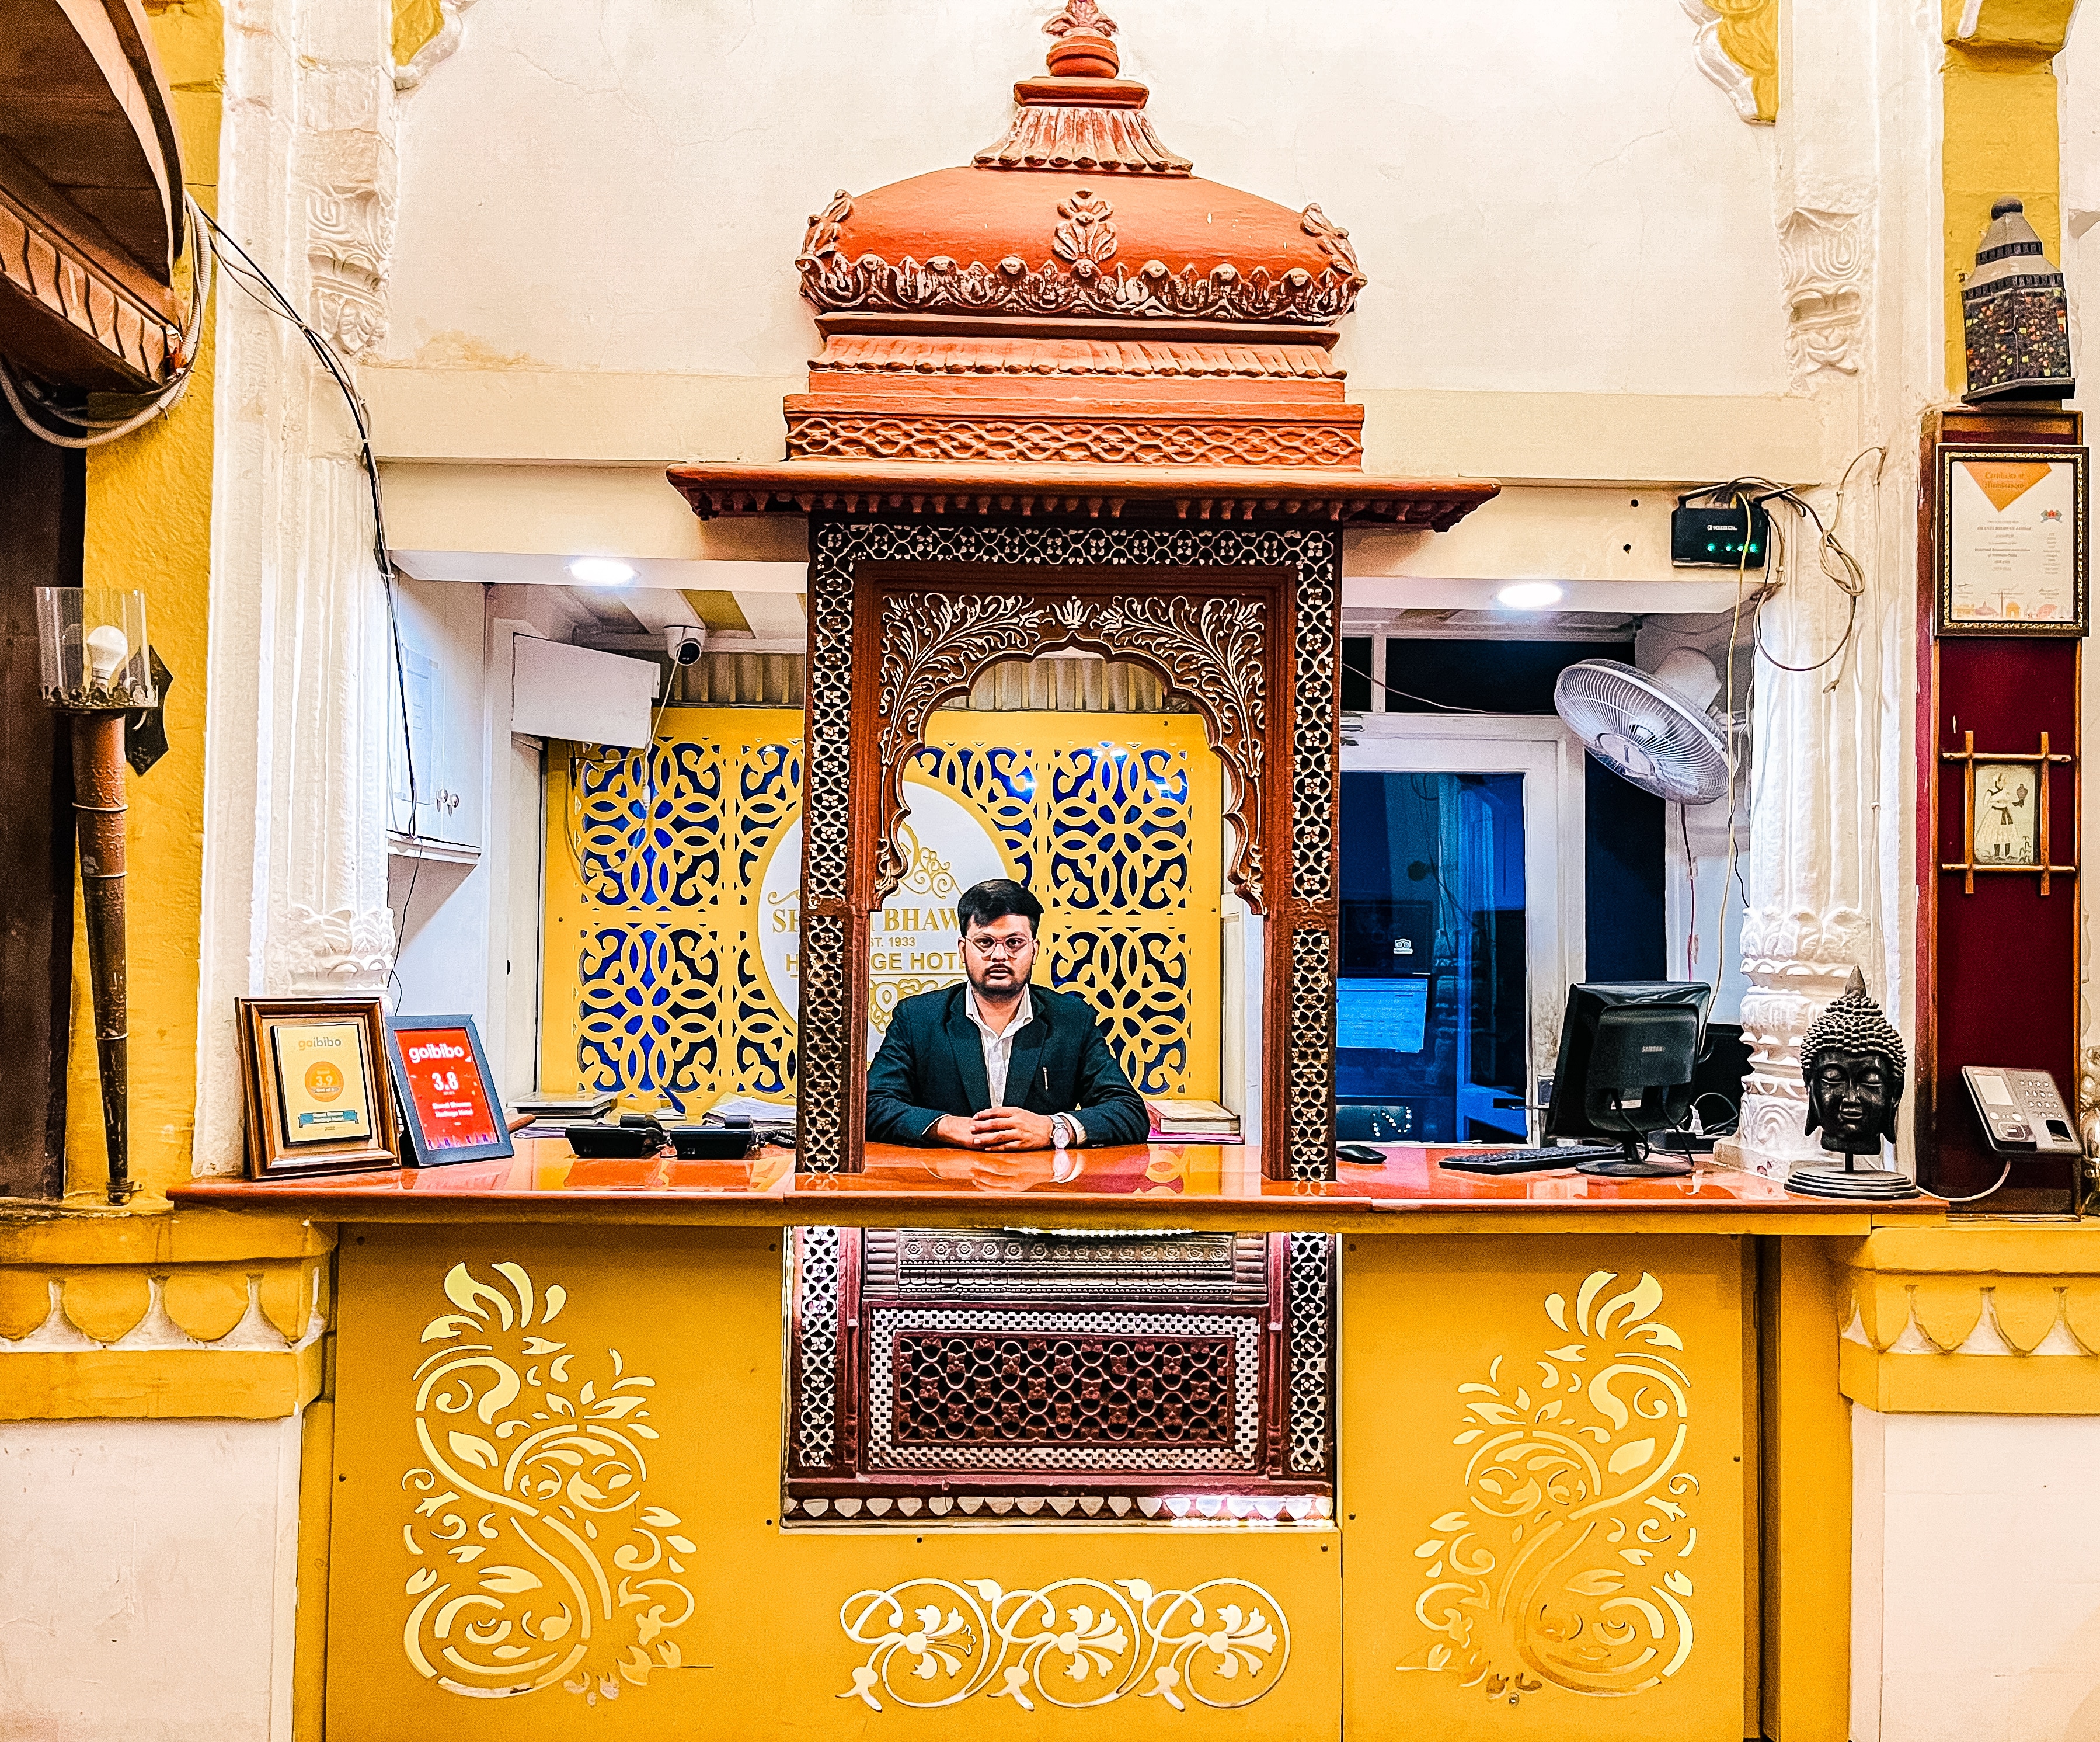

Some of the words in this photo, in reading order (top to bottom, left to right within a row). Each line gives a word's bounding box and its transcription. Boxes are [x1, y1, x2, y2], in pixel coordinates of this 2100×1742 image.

[883, 908, 959, 931] BHAW
[870, 937, 884, 947] ST.
[889, 937, 915, 947] 1933
[298, 1037, 342, 1051] goibibo
[409, 1043, 464, 1063] goibibo
[315, 1075, 333, 1086] 3.9
[431, 1071, 459, 1091] 3.8
